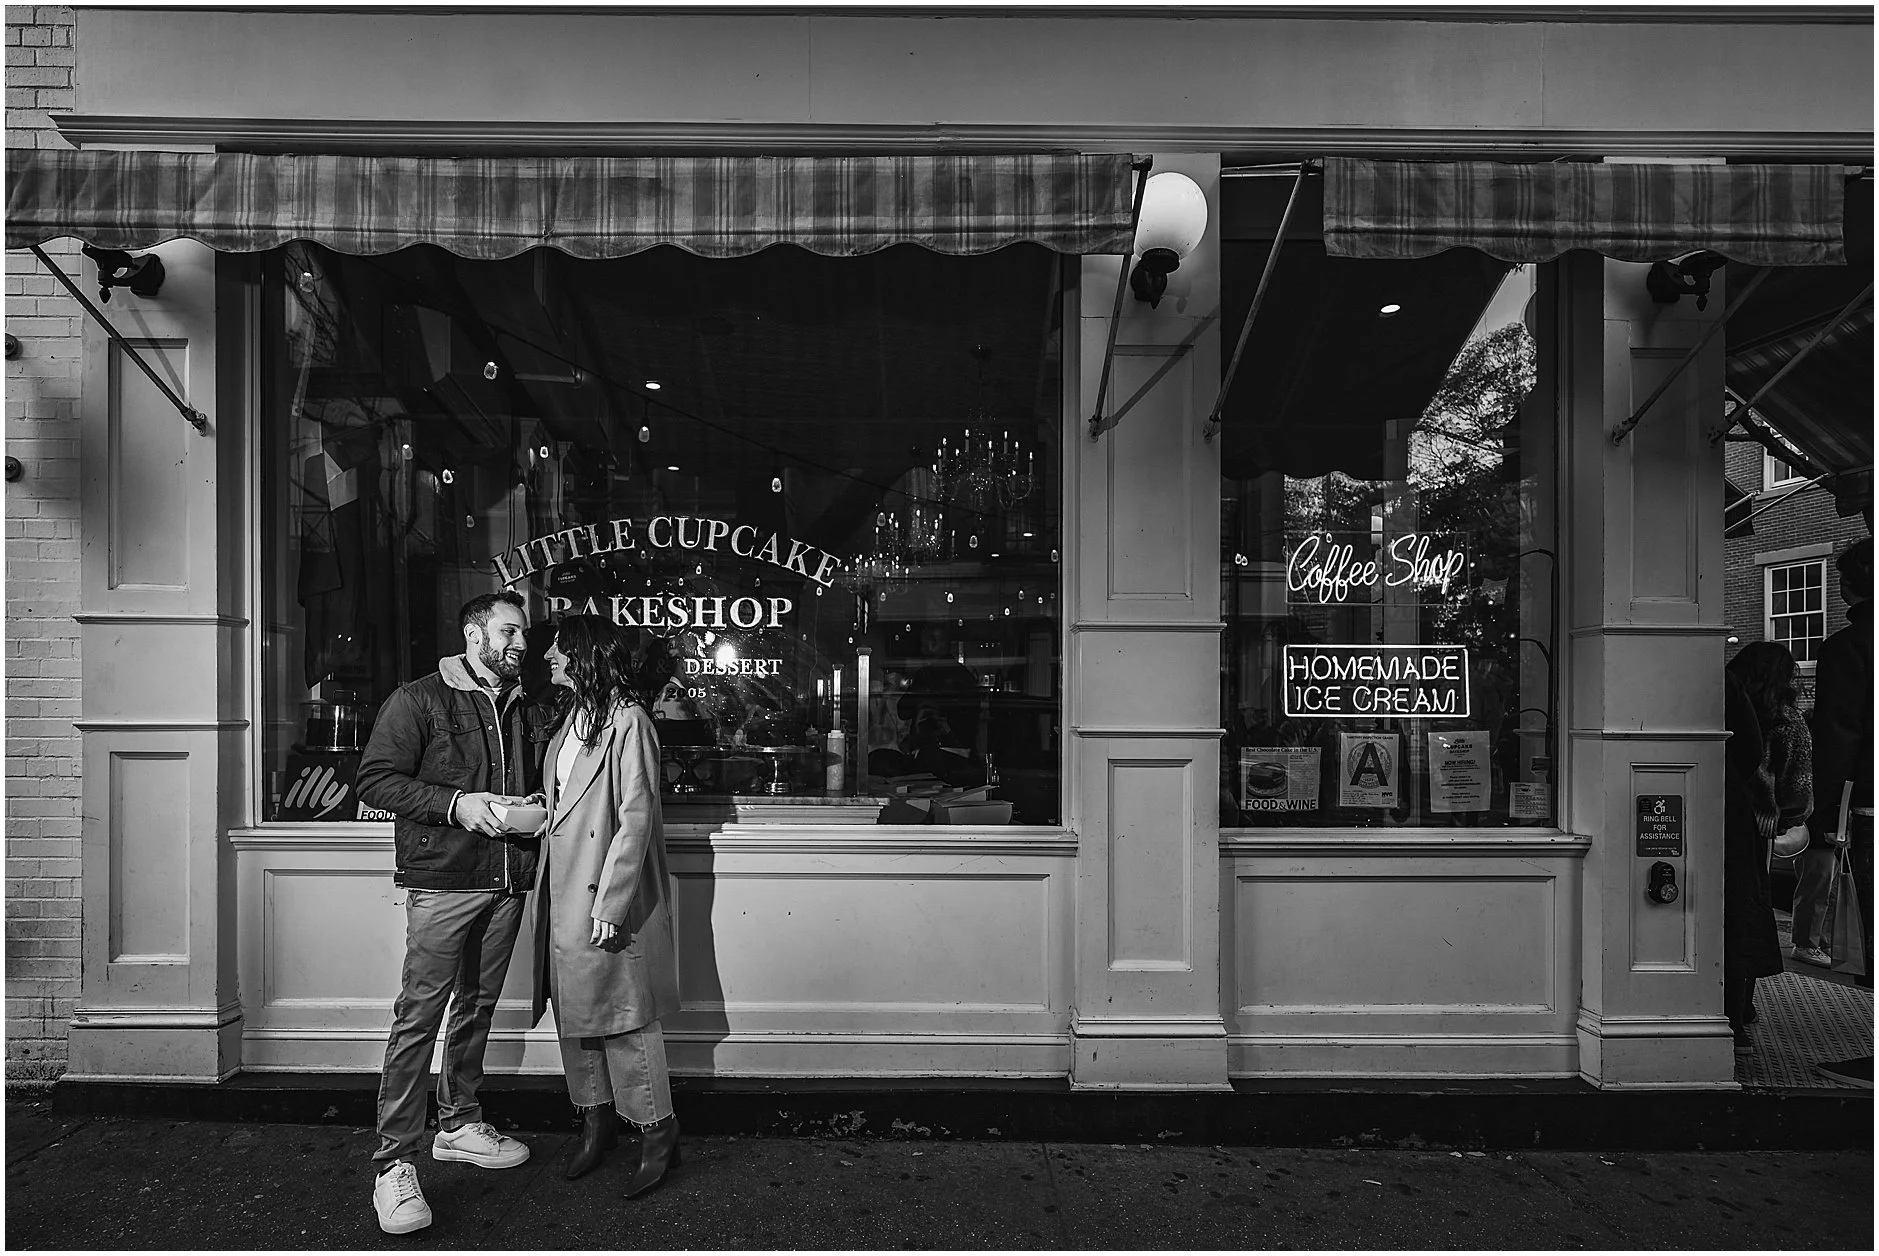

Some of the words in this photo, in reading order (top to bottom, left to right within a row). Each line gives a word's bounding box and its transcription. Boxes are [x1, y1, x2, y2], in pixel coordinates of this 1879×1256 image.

[490, 518, 635, 588] LITTLE
[648, 516, 841, 588] CUPCAKE
[1288, 536, 1378, 603] Coffee
[1385, 534, 1463, 594] Shop
[684, 658, 783, 675] DESSERT
[1288, 655, 1460, 681] HOMEMADE
[1296, 686, 1341, 711] ICE
[1352, 686, 1455, 712] CREAM
[1349, 742, 1389, 786] A
[284, 765, 349, 818] illy
[1639, 832, 1680, 840] ASSISTANCE
